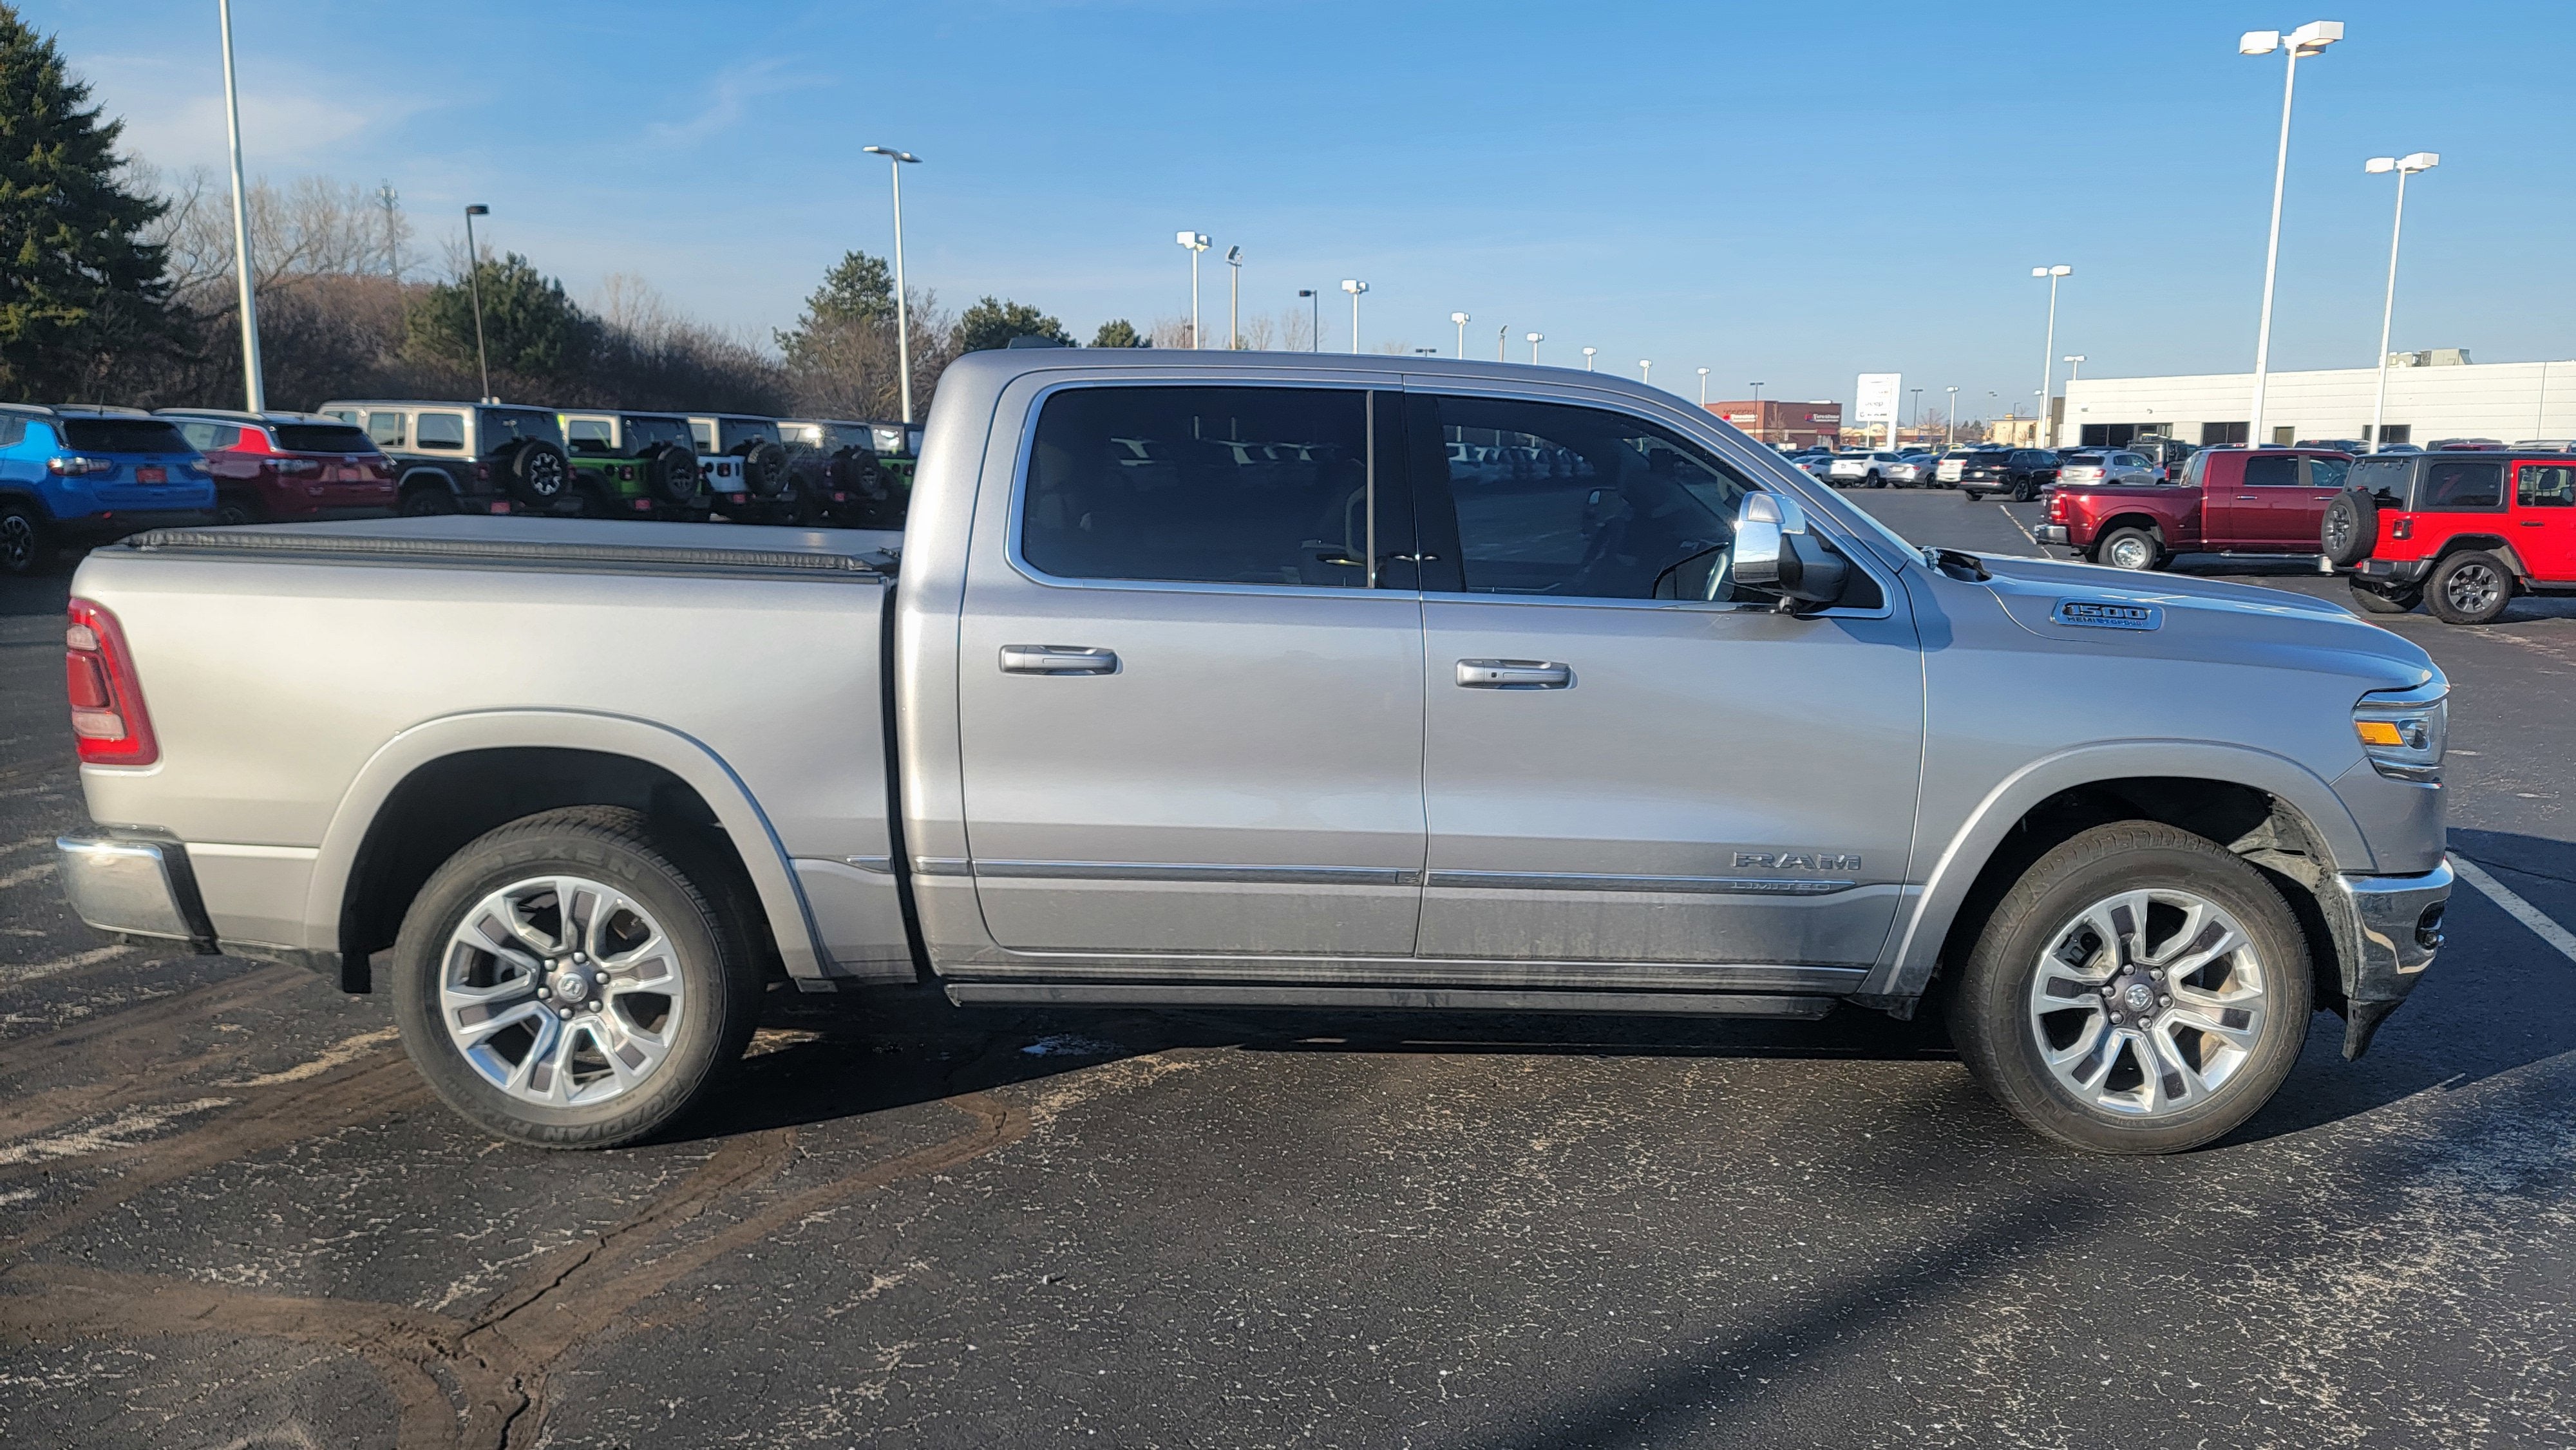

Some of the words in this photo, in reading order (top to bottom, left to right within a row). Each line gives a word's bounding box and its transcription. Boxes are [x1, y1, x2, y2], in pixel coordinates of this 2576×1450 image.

[2063, 604, 2148, 619] 1500
[1732, 851, 1861, 870] RAM
[1730, 881, 1830, 891] LIMITED
